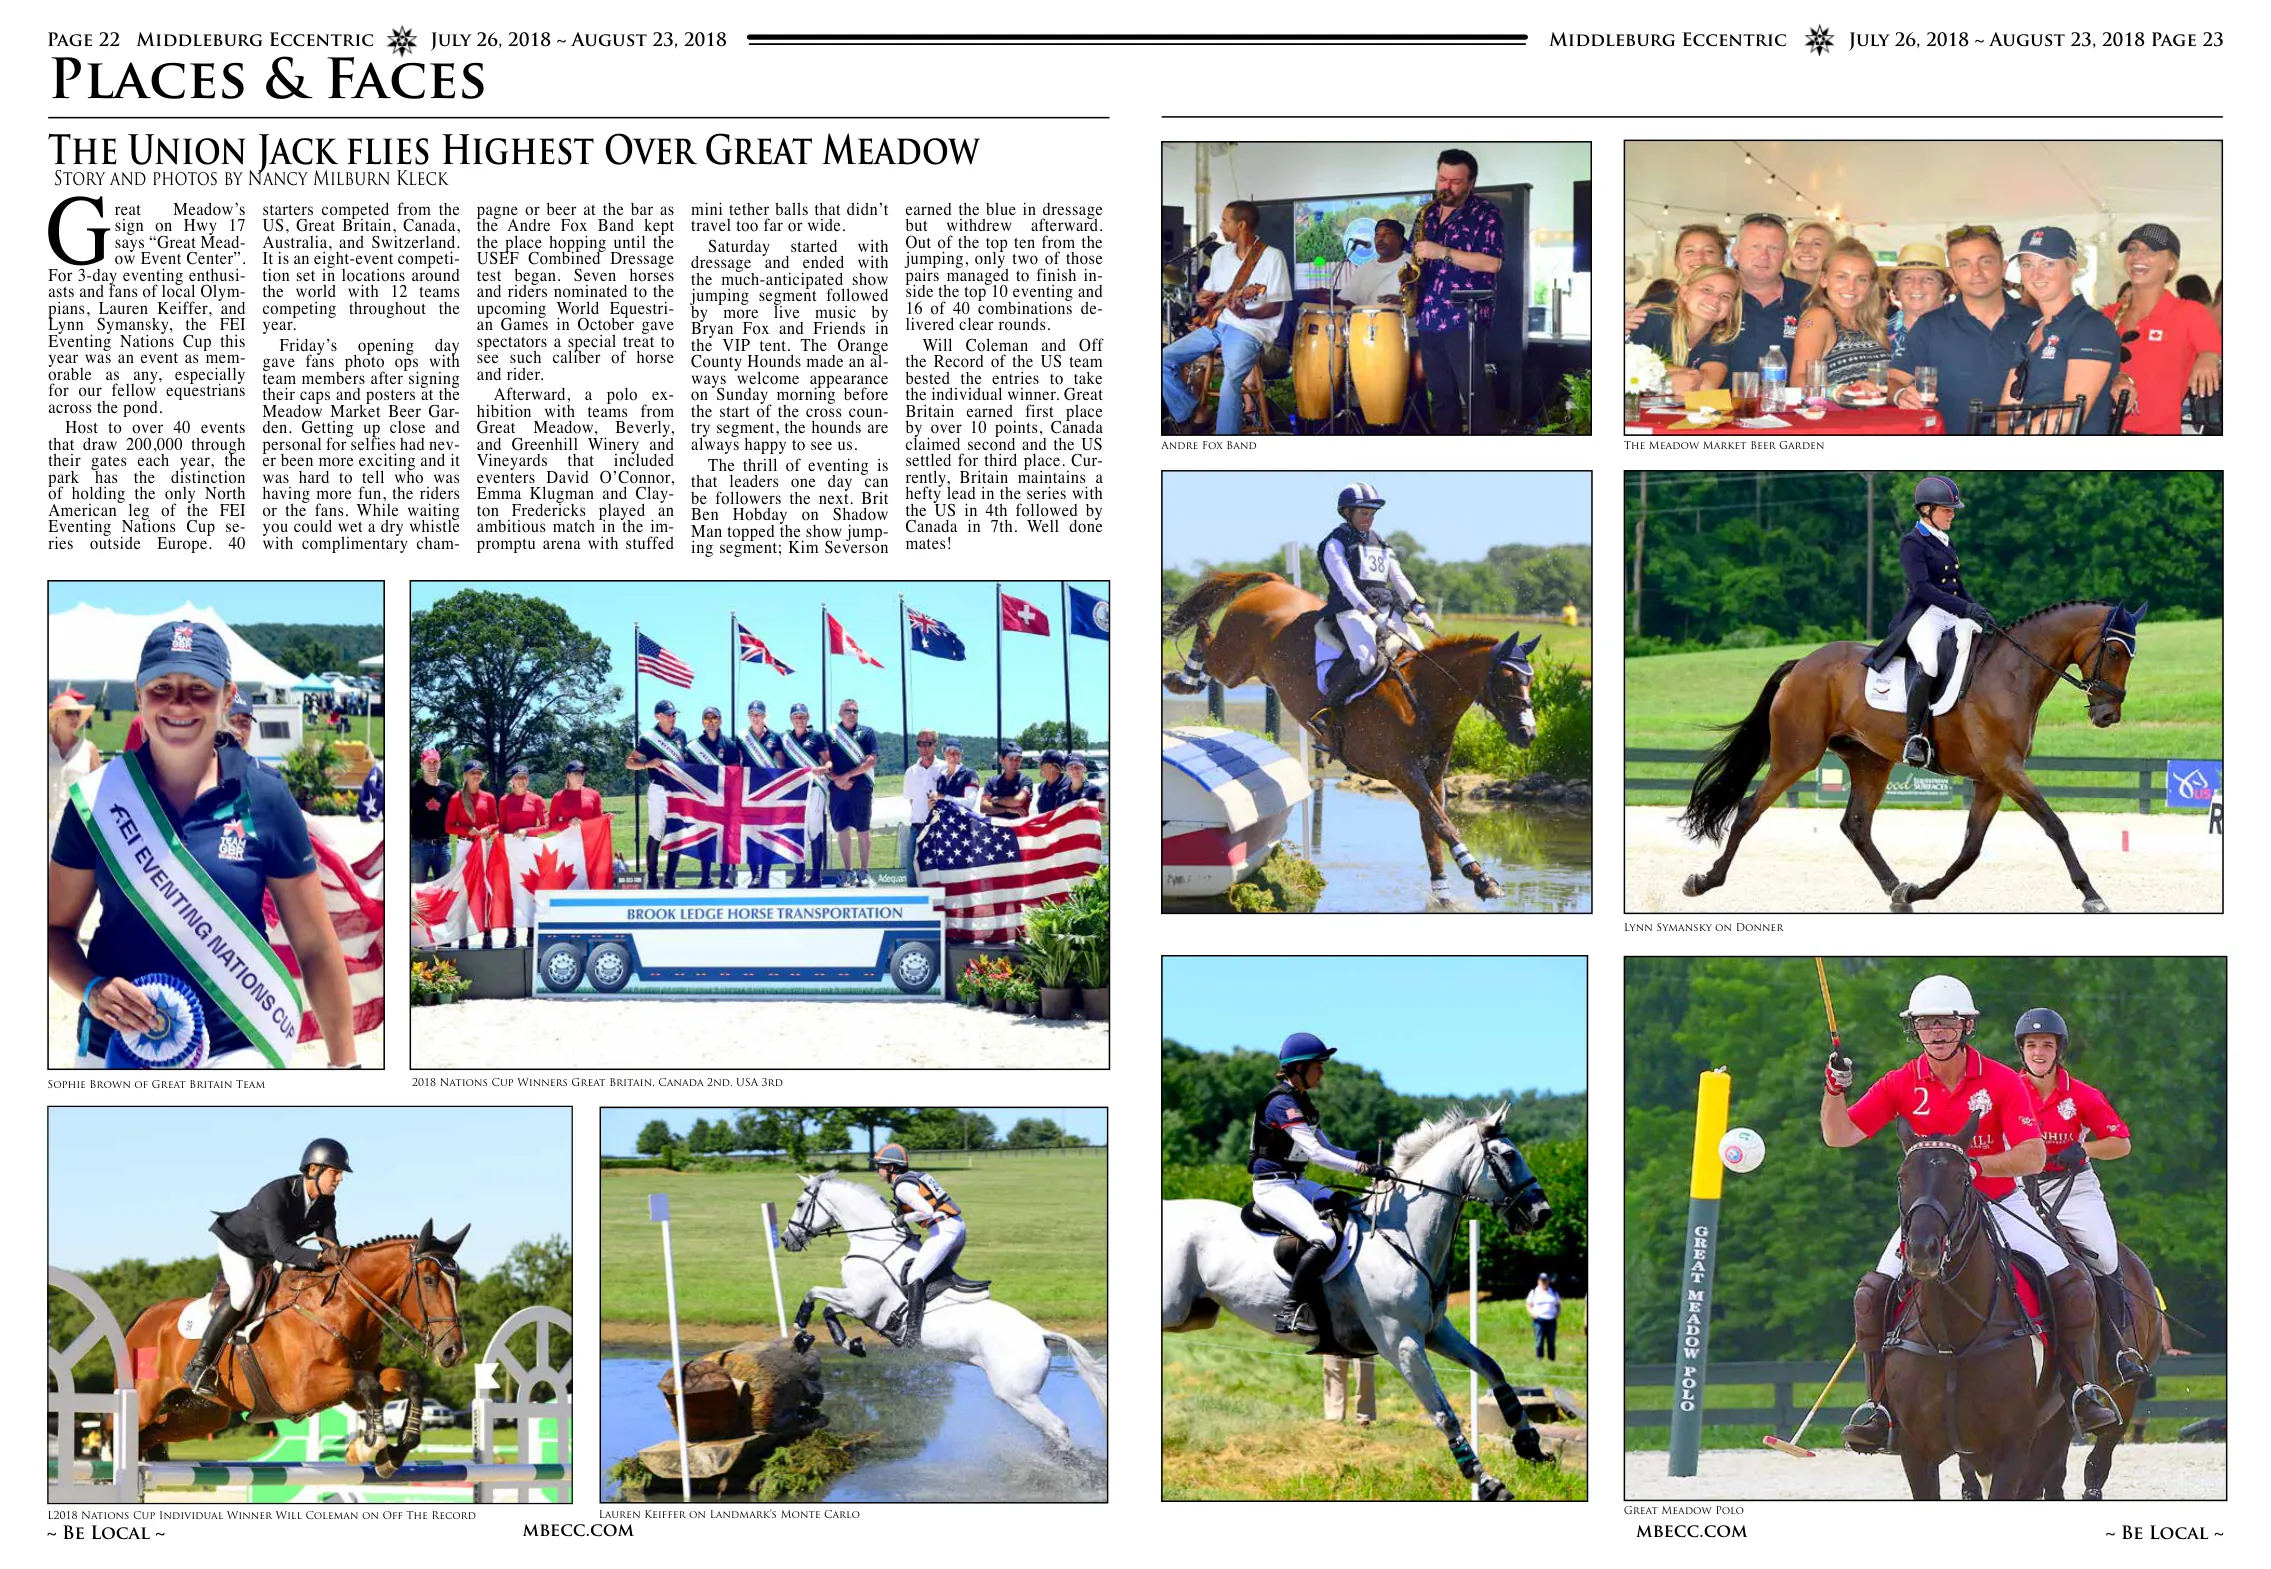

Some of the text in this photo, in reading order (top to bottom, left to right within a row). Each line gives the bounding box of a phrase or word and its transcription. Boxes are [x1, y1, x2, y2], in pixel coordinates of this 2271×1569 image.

[49, 32, 373, 46] PAGE 22 MIDDLEBURG ECCENTRIC
[432, 32, 471, 50] JULY
[477, 32, 501, 48] 26,
[509, 32, 550, 46] 2018
[572, 32, 647, 46] AUGUST
[653, 32, 677, 48] 23,
[685, 32, 726, 46] 2018
[1550, 32, 1786, 46] MIDDLEBURG ECCENTRIC
[1850, 32, 1889, 50] JULY
[1895, 32, 1919, 47] 26,
[1927, 32, 1968, 46] 2018
[1990, 32, 2065, 46] AUGUST
[2071, 32, 2095, 47] 23,
[2103, 32, 2144, 46] 2018
[2153, 32, 2196, 46] PAGE
[2203, 32, 2223, 46] 23
[52, 56, 484, 99] PLACES & FACES
[48, 134, 979, 168] THE UNION JACK FLIES HIGHEST OVER GREAT MEADOW
[55, 171, 448, 185] STORY AND PHOTOS BY NANCY MILBURN KLECK
[692, 203, 722, 215] mini
[730, 203, 769, 215] tether
[776, 203, 808, 215] balls
[815, 203, 840, 215] that
[692, 219, 845, 231] travel too far or wide.
[906, 318, 1050, 330] livered clear rounds.
[923, 339, 1103, 351] Will Coleman and Off
[263, 405, 459, 417] Meadow Market Beer Gar-
[477, 405, 673, 417] hibition with teams from
[66, 421, 245, 433] Host to over 40 events
[1162, 441, 1256, 449] ANDRE FOX BAND
[1624, 441, 1825, 450] THE MEADOW MARKET BEER GARDEN
[1368, 555, 1385, 573] 38
[220, 836, 246, 848] TEAM
[627, 906, 903, 920] BROOK LEDGE HORSE TRANSPORTATION
[1625, 923, 1652, 931] LYNN
[1657, 923, 1712, 931] SYMANSKY
[1737, 923, 1783, 931] DONNER
[136, 847, 212, 940] EVENTING
[207, 936, 276, 1012] NATIONS
[272, 1007, 296, 1038] CUP
[48, 1080, 85, 1088] SOPHIE
[91, 1080, 130, 1088] BROWN
[152, 1080, 186, 1088] GREAT
[190, 1080, 232, 1088] BRITAIN
[236, 1080, 265, 1088] TEAM
[412, 1078, 436, 1086] 2018
[441, 1078, 487, 1086] NATIONS
[492, 1078, 513, 1086] CUP
[518, 1078, 567, 1086] WINNERS
[572, 1078, 605, 1086] GREAT
[659, 1078, 703, 1086] CANADA
[737, 1078, 758, 1086] USA
[762, 1078, 783, 1086] 3RD
[1912, 1087, 1931, 1115] 2
[1680, 1226, 1709, 1412] GREAT MEADOW POLO
[49, 1511, 77, 1519] L2018
[82, 1511, 129, 1519] NATIONS
[134, 1511, 155, 1519] CUP
[160, 1511, 223, 1519] INDIVIDUAL
[227, 1511, 272, 1519] WINNER
[276, 1511, 302, 1519] WILL
[306, 1511, 358, 1519] COLEMAN
[383, 1511, 402, 1519] OFF
[406, 1511, 427, 1519] THE
[433, 1511, 476, 1519] RECORD
[600, 1510, 640, 1518] LAUREN
[645, 1510, 686, 1518] KEIFFER
[781, 1510, 820, 1518] MONTE
[825, 1510, 860, 1518] CARLO
[1624, 1506, 1744, 1514] GREAT MEADOW POLO
[64, 1525, 84, 1539] BE
[92, 1525, 150, 1539] LOCAL
[523, 1524, 633, 1536] MBECC.COM
[1637, 1525, 1747, 1537] MBECC.COM
[2123, 1525, 2142, 1539] BE
[2151, 1525, 2208, 1539] LOCAL
